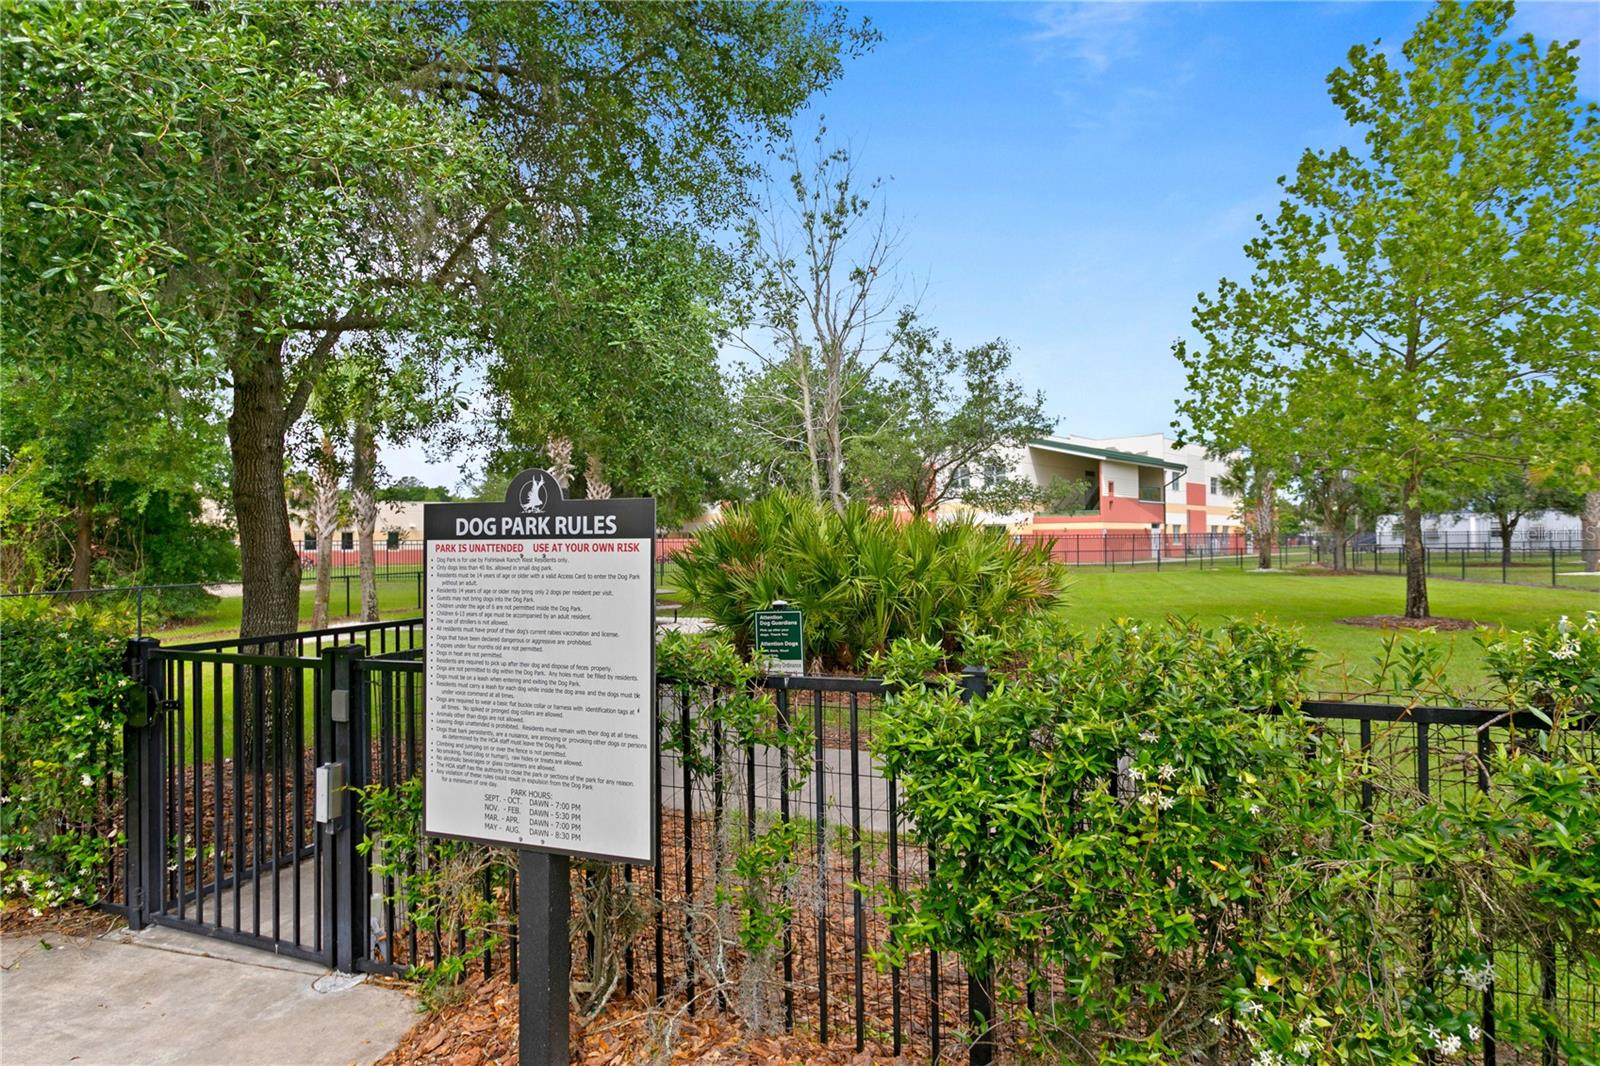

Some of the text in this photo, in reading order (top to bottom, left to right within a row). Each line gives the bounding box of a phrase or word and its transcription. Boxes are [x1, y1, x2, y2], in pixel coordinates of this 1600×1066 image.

[456, 515, 617, 536] DOG PARK RULES
[468, 544, 523, 552] UNATTENDED
[532, 543, 548, 552] USE
[551, 543, 562, 551] AT
[565, 543, 589, 551] YOUR
[592, 543, 614, 551] OWN
[617, 543, 639, 551] RISK
[484, 793, 501, 802] SEPT.
[507, 796, 522, 805] OCT.
[528, 798, 549, 808] DAWN
[555, 801, 569, 810] 7:00
[570, 803, 581, 812] PM
[510, 788, 552, 800] PARK HOURS:
[484, 803, 499, 812] NOV.
[507, 805, 520, 814] FEB.
[528, 808, 549, 818] DAWN
[555, 811, 569, 820] 5:30
[570, 813, 581, 822] PM
[484, 812, 498, 821] MAR.
[505, 815, 520, 824] APR.
[528, 818, 549, 827] DAWN
[555, 821, 569, 830] 7:00
[570, 823, 581, 831] PM
[484, 822, 497, 831] MAY
[505, 825, 520, 834] AUG.
[529, 828, 549, 837] DAWN
[554, 831, 569, 840] 8:30
[570, 833, 581, 841] PM
